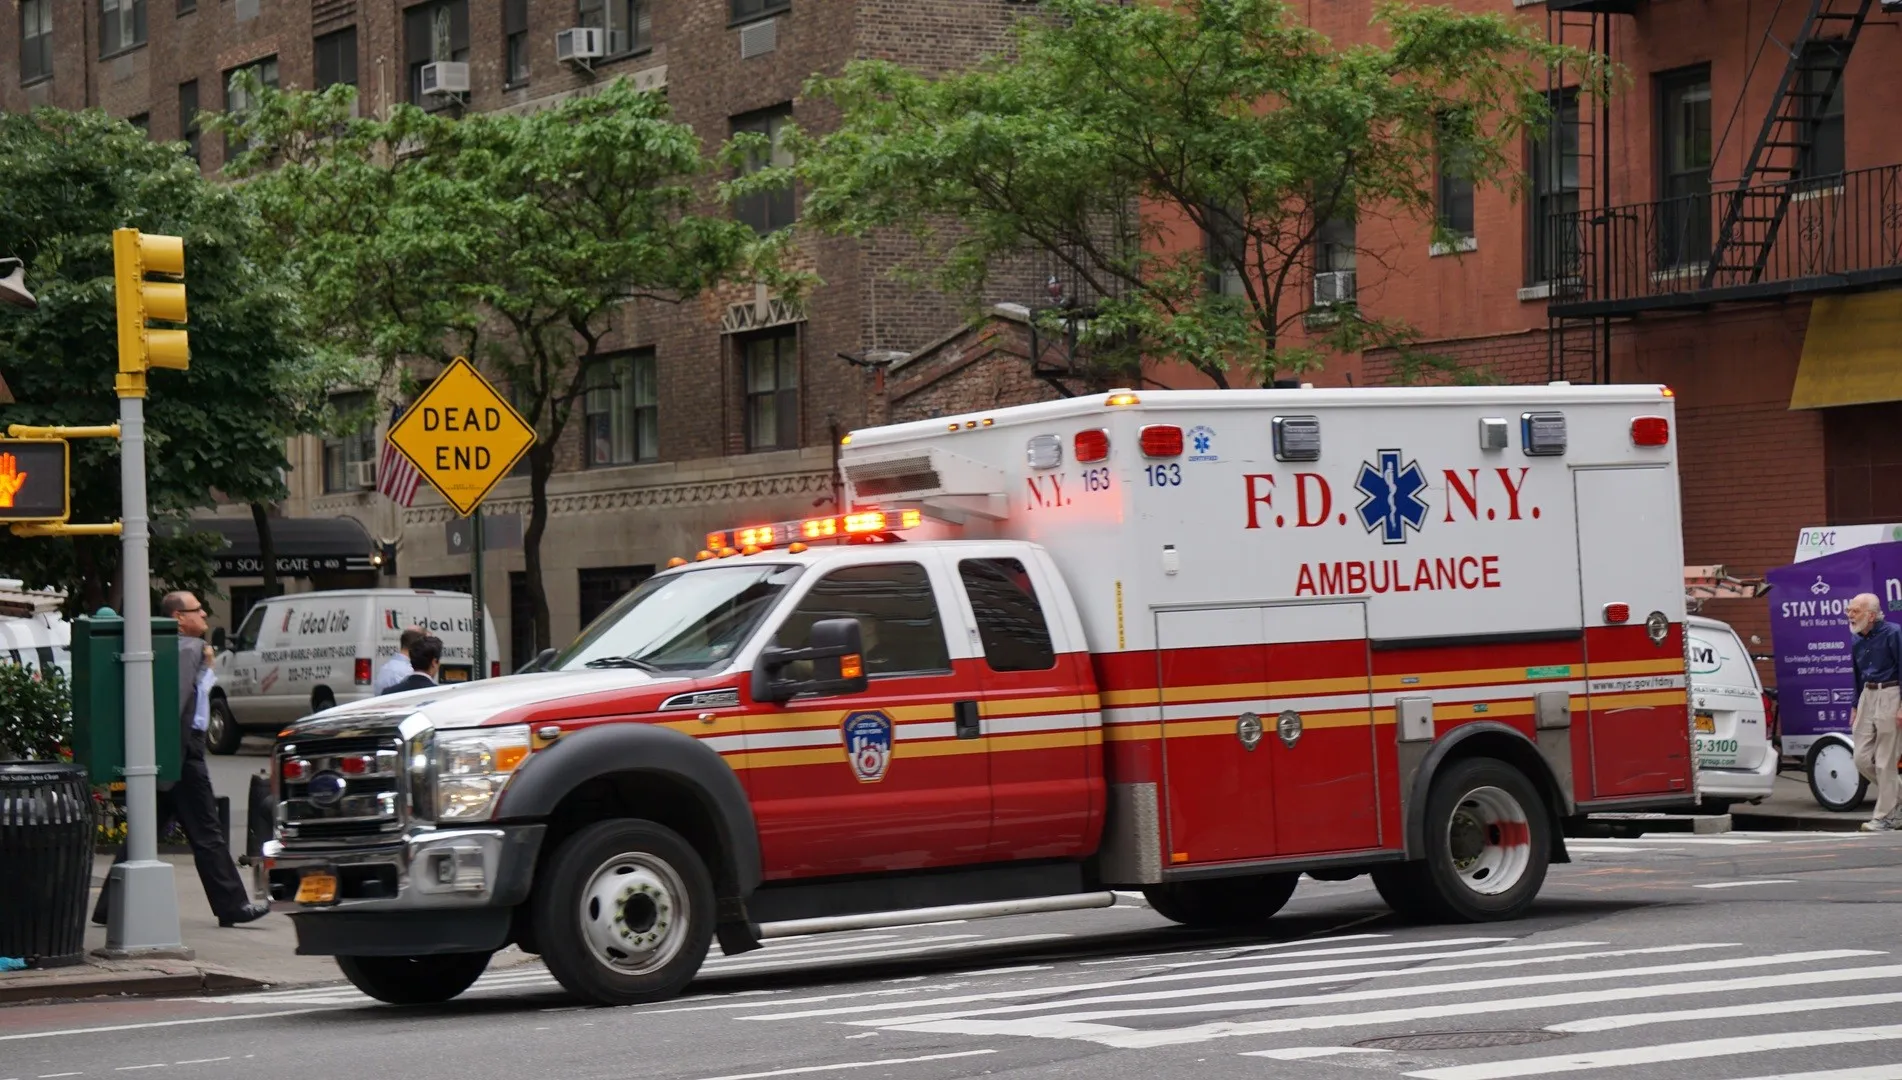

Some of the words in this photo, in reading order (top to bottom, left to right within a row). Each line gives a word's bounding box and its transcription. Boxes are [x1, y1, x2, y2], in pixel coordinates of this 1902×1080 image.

[423, 407, 500, 432] DEAD
[436, 446, 490, 470] END
[1081, 467, 1110, 492] 163
[1145, 463, 1181, 487] 163
[1026, 472, 1071, 510] N.Y.
[1243, 472, 1347, 529] F.D.
[1442, 467, 1542, 522] N.Y.
[1800, 530, 1836, 546] next
[324, 559, 340, 569] 400
[1295, 555, 1501, 597] AMBULANCE
[1781, 600, 1817, 618] STAY
[1820, 598, 1853, 616] HO
[299, 611, 329, 636] ideal
[329, 609, 350, 632] tile
[412, 617, 453, 632] ideal
[457, 618, 474, 632] til
[1815, 618, 1828, 626] Ride
[1837, 617, 1849, 625] You
[1818, 641, 1845, 650] DEMAND
[1820, 654, 1841, 662] Cleaning
[1841, 653, 1852, 661] and
[1592, 675, 1674, 691] www.nyc.gov/fdny
